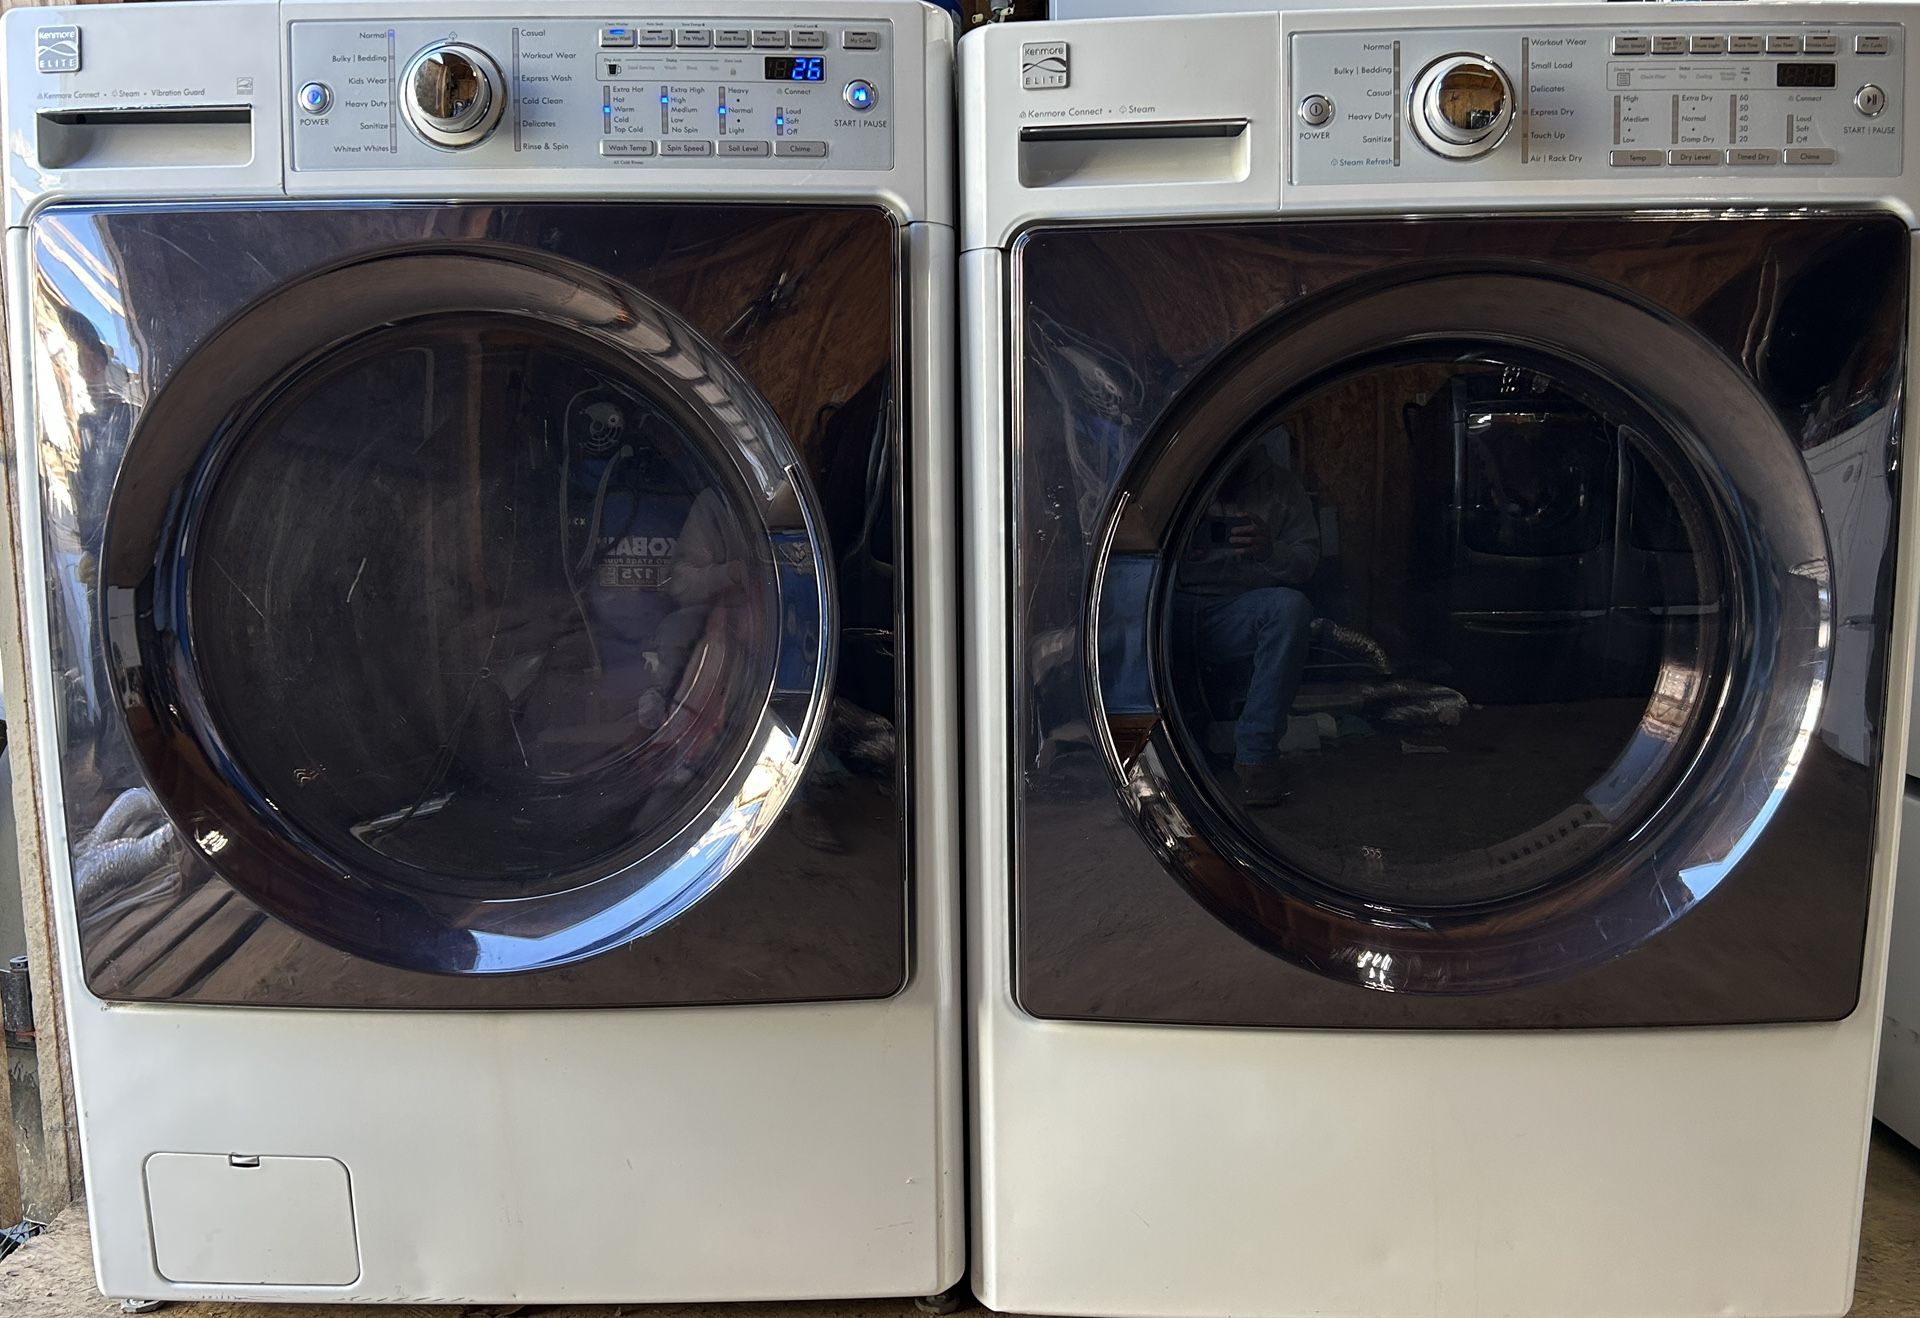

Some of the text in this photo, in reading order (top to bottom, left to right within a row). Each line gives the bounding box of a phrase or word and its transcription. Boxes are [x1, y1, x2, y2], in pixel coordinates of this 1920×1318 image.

[38, 30, 76, 40] Kenmore
[359, 32, 386, 40] Normal
[520, 29, 546, 37] Casual
[1530, 38, 1587, 46] Workout Wear
[1024, 47, 1064, 56] Kenmore
[1363, 44, 1392, 52] Normal
[332, 54, 388, 64] Bulky Bedding
[522, 52, 577, 60] Workout Wear
[40, 58, 74, 68] ELITE
[1530, 62, 1552, 70] Small
[792, 58, 821, 80] 26
[1334, 66, 1392, 76] Bulky Bedding
[348, 76, 388, 85] Kids Wear
[521, 74, 572, 83] Express Wash
[1026, 76, 1064, 86] ELITE
[688, 86, 705, 94] High
[1366, 88, 1392, 97] Casual
[1530, 85, 1566, 93] Delicates
[43, 88, 206, 100] Kenmore Connect Steam Vibration Guard
[1700, 94, 1713, 102] Dry
[1740, 94, 1748, 102] 60
[1796, 94, 1822, 102] Connect
[522, 97, 563, 105] Cold Clean
[670, 96, 686, 104] High
[345, 100, 388, 110] Heavy Duty
[1028, 104, 1156, 119] Kenmore Connect Steam
[1530, 108, 1574, 117] Express Dry
[1348, 112, 1392, 121] Heavy Duty
[300, 118, 330, 126] POWER
[360, 122, 388, 130] Sanitize
[522, 120, 556, 128] Delicates
[834, 120, 887, 128] START PAUSE
[613, 126, 626, 134] Tap
[786, 128, 798, 136] Off
[1843, 126, 1896, 134] START PAUSE
[1300, 132, 1330, 140] POWER
[1362, 136, 1392, 144] Sanitize
[1554, 132, 1566, 140] Up
[1681, 136, 1715, 144] Damp Dry
[334, 144, 390, 153] Whitest Whites
[522, 142, 569, 152] Rinse & Spin
[666, 145, 682, 153] Spin
[1548, 154, 1566, 162] Rack
[1569, 154, 1582, 163] Dry
[1630, 154, 1646, 162] Temp
[1680, 154, 1692, 162] Dry
[1758, 153, 1770, 161] Dry
[1800, 152, 1820, 160] Chime
[1366, 158, 1392, 166] Refresh
